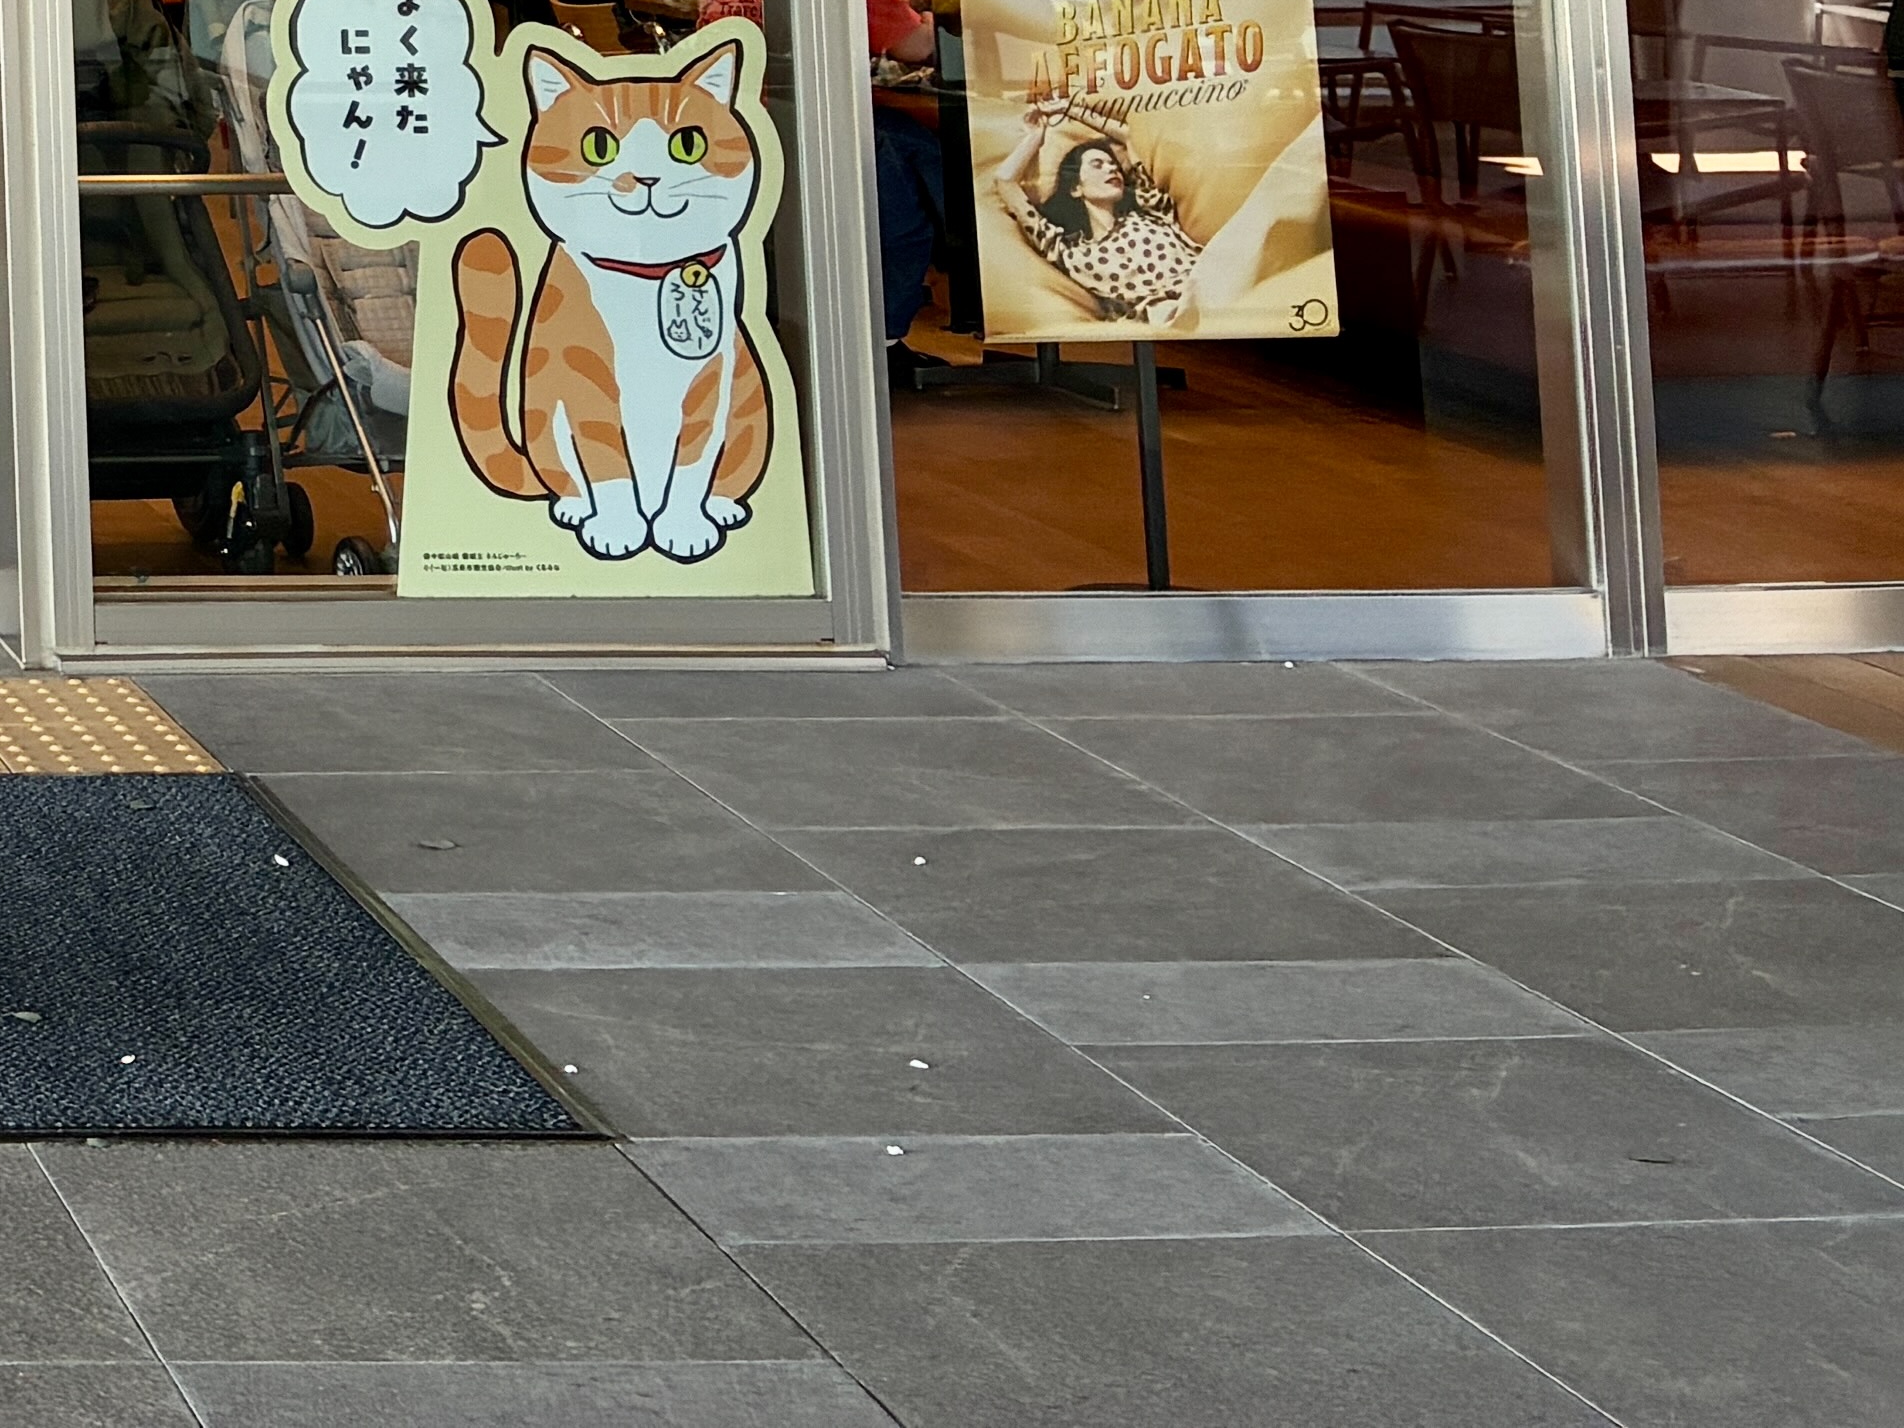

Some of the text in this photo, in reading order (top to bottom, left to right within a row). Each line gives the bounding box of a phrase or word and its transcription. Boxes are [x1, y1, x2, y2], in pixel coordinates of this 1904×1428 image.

[340, 27, 373, 169] にゃん!
[1025, 19, 1264, 105] AFFOGATO
